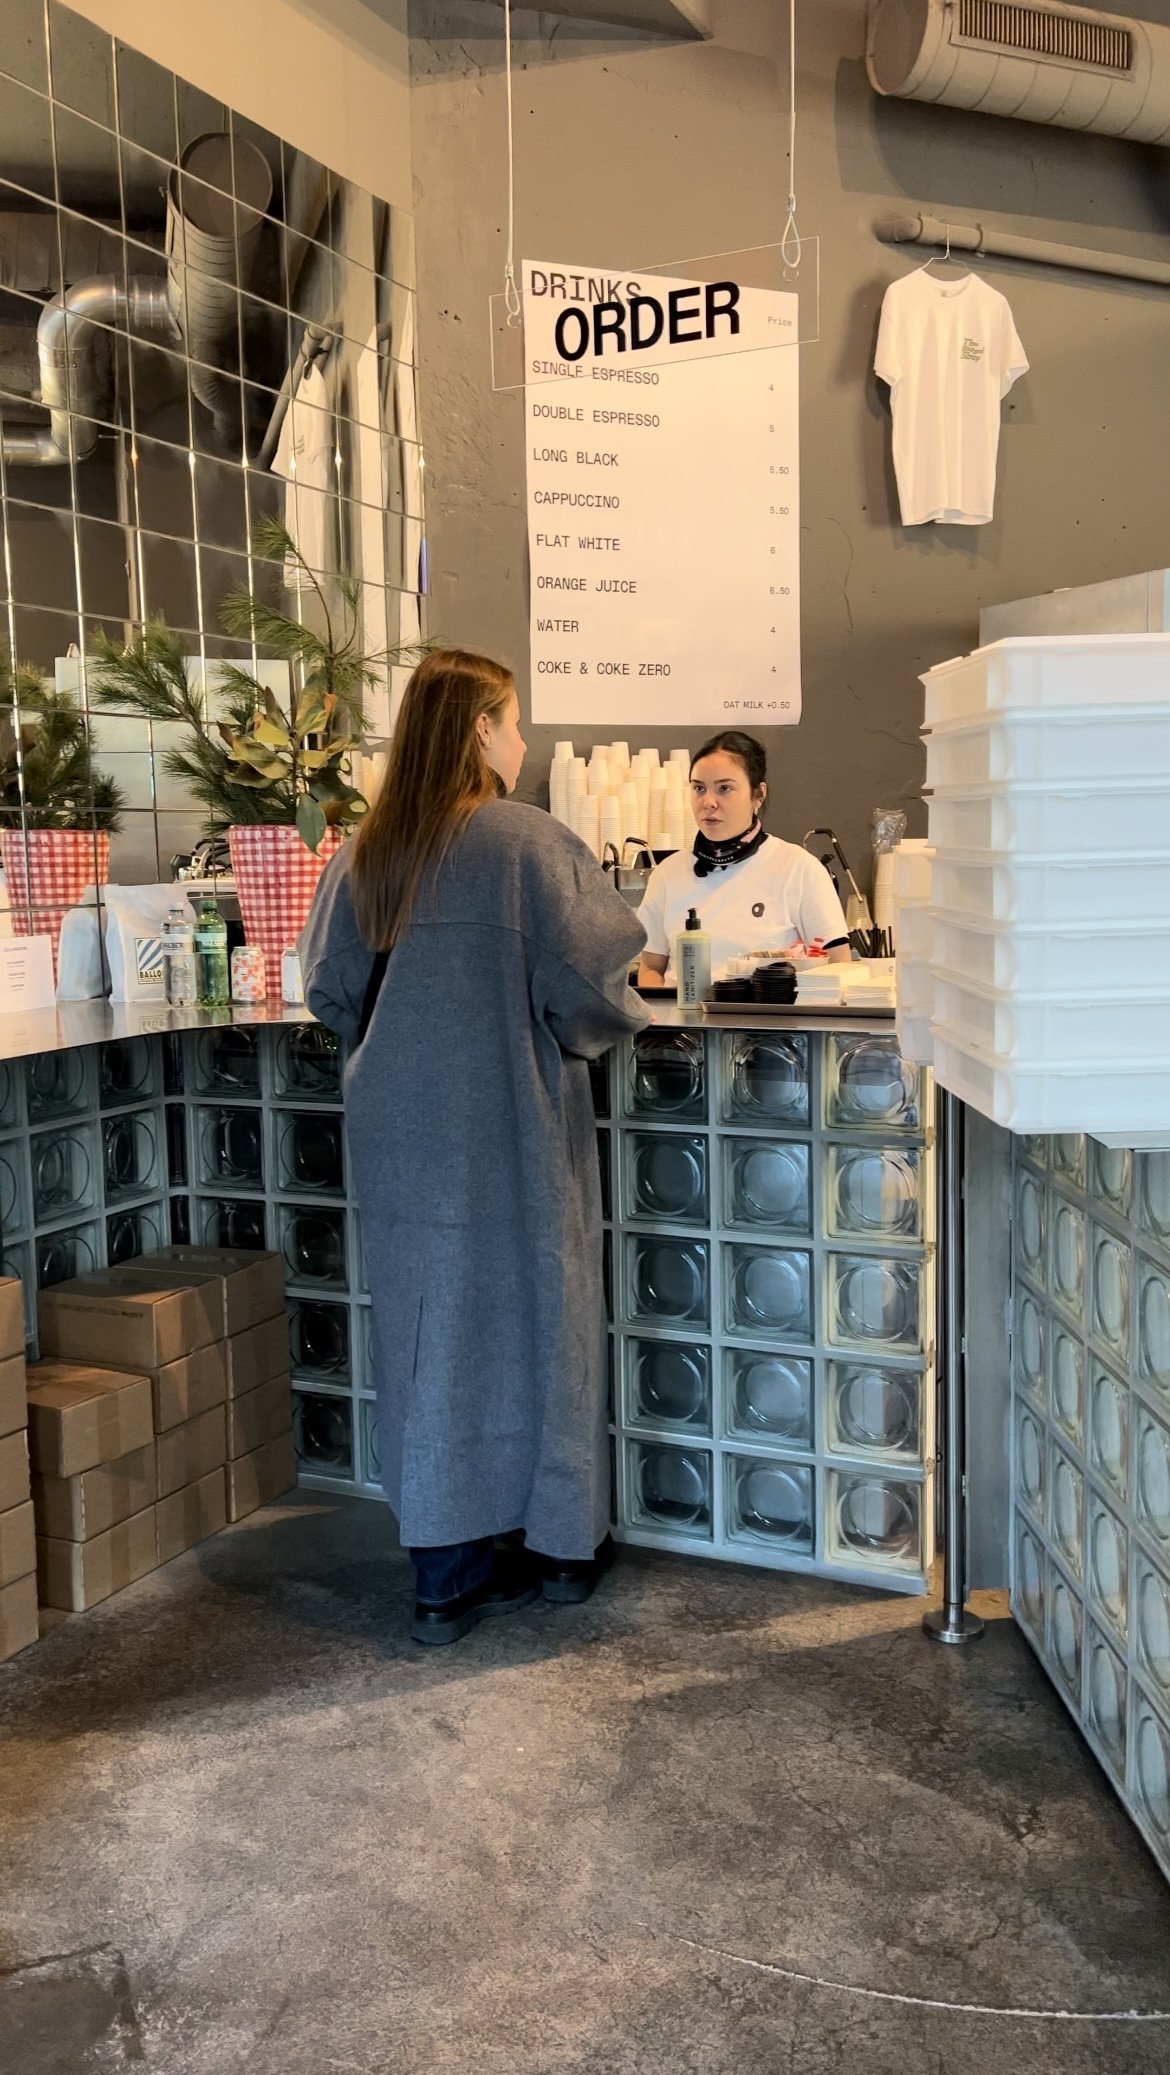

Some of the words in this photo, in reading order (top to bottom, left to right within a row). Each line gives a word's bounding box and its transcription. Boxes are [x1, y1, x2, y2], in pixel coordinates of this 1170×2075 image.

[531, 270, 642, 303] DRINKS
[554, 281, 740, 362] ORDER
[767, 316, 793, 328] Price
[532, 360, 584, 378] SINGLE
[592, 366, 660, 385] ESPRESSO
[768, 383, 774, 392] 4
[532, 404, 584, 421] DOUBLE
[592, 409, 660, 428] ESPRESSO
[768, 424, 775, 433] 5
[533, 447, 568, 463] LONG
[576, 451, 619, 467] BLACK
[769, 465, 790, 475] 5.50
[534, 491, 620, 509] CAPPUCCINO
[769, 506, 790, 516] 5.50
[536, 534, 570, 548] FLAT
[578, 537, 621, 551] WHITE
[770, 546, 776, 555] 6
[536, 576, 587, 591] ORANGE
[595, 580, 637, 593] JUICE
[769, 586, 790, 595] 6.50
[536, 619, 579, 633] WATER
[770, 626, 776, 634] 4
[537, 661, 572, 674] COKE
[579, 662, 588, 675] &
[596, 663, 631, 676] COKE
[638, 663, 671, 676] ZERO
[723, 700, 740, 709] OAT
[743, 700, 763, 709] MILK
[766, 701, 791, 710] +0.50
[139, 969, 162, 978] BALLO
